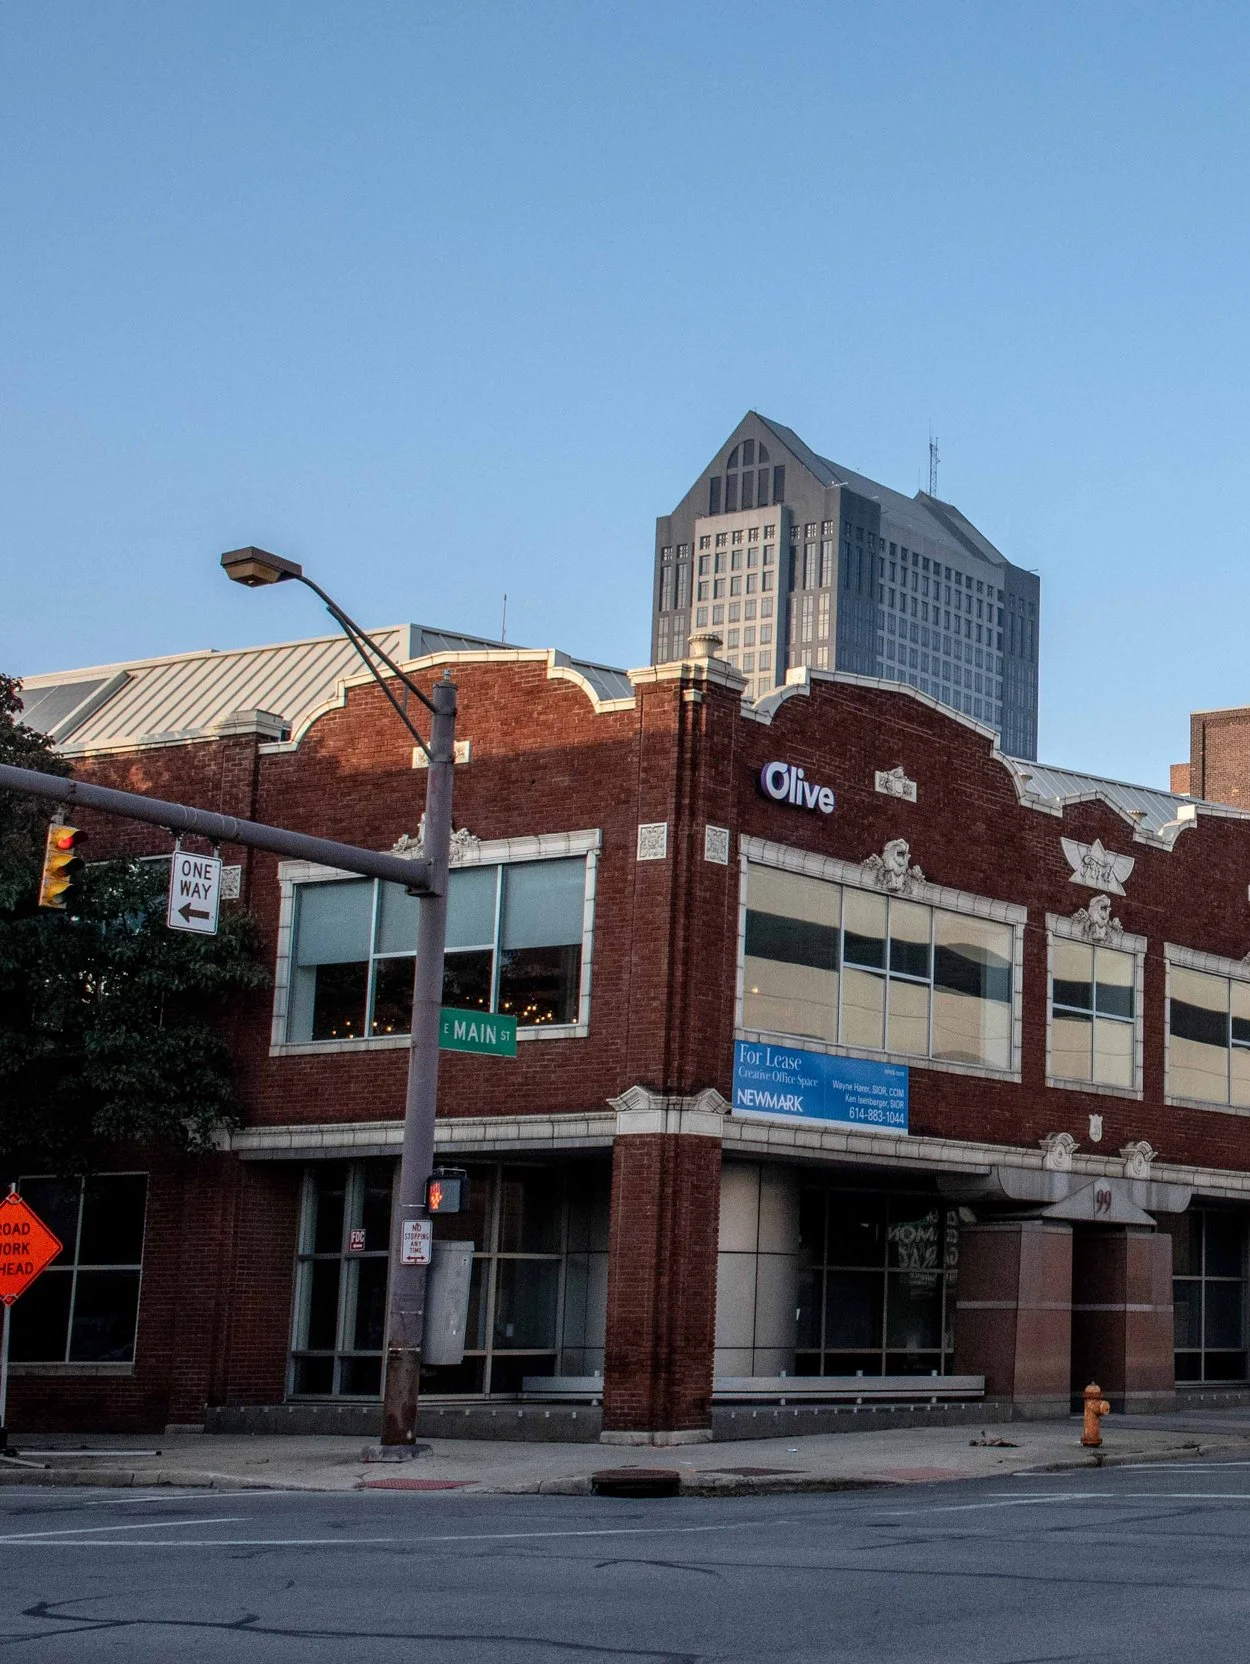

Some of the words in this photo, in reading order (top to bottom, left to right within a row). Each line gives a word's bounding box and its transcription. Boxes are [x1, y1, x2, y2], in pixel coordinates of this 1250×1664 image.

[763, 761, 835, 814] Olive
[182, 860, 213, 880] ONE
[180, 880, 212, 900] WAY
[444, 1023, 450, 1034] E
[453, 1020, 497, 1045] MAIN
[500, 1030, 511, 1041] ST
[740, 1044, 762, 1065] For
[766, 1048, 802, 1071] Lease
[738, 1066, 771, 1080] Creative
[772, 1071, 796, 1085] Office
[797, 1075, 819, 1088] Space
[832, 1080, 853, 1091] Wayne
[737, 1088, 803, 1112] NEWMARK
[845, 1093, 857, 1103] Ken
[849, 1106, 905, 1125] 614-883-1044
[1096, 1189, 1112, 1214] 99
[0, 1222, 31, 1236] OAD
[352, 1231, 365, 1243] FDC
[412, 1224, 422, 1232] NO
[0, 1242, 31, 1256] ORK
[0, 1262, 34, 1275] HEAD
